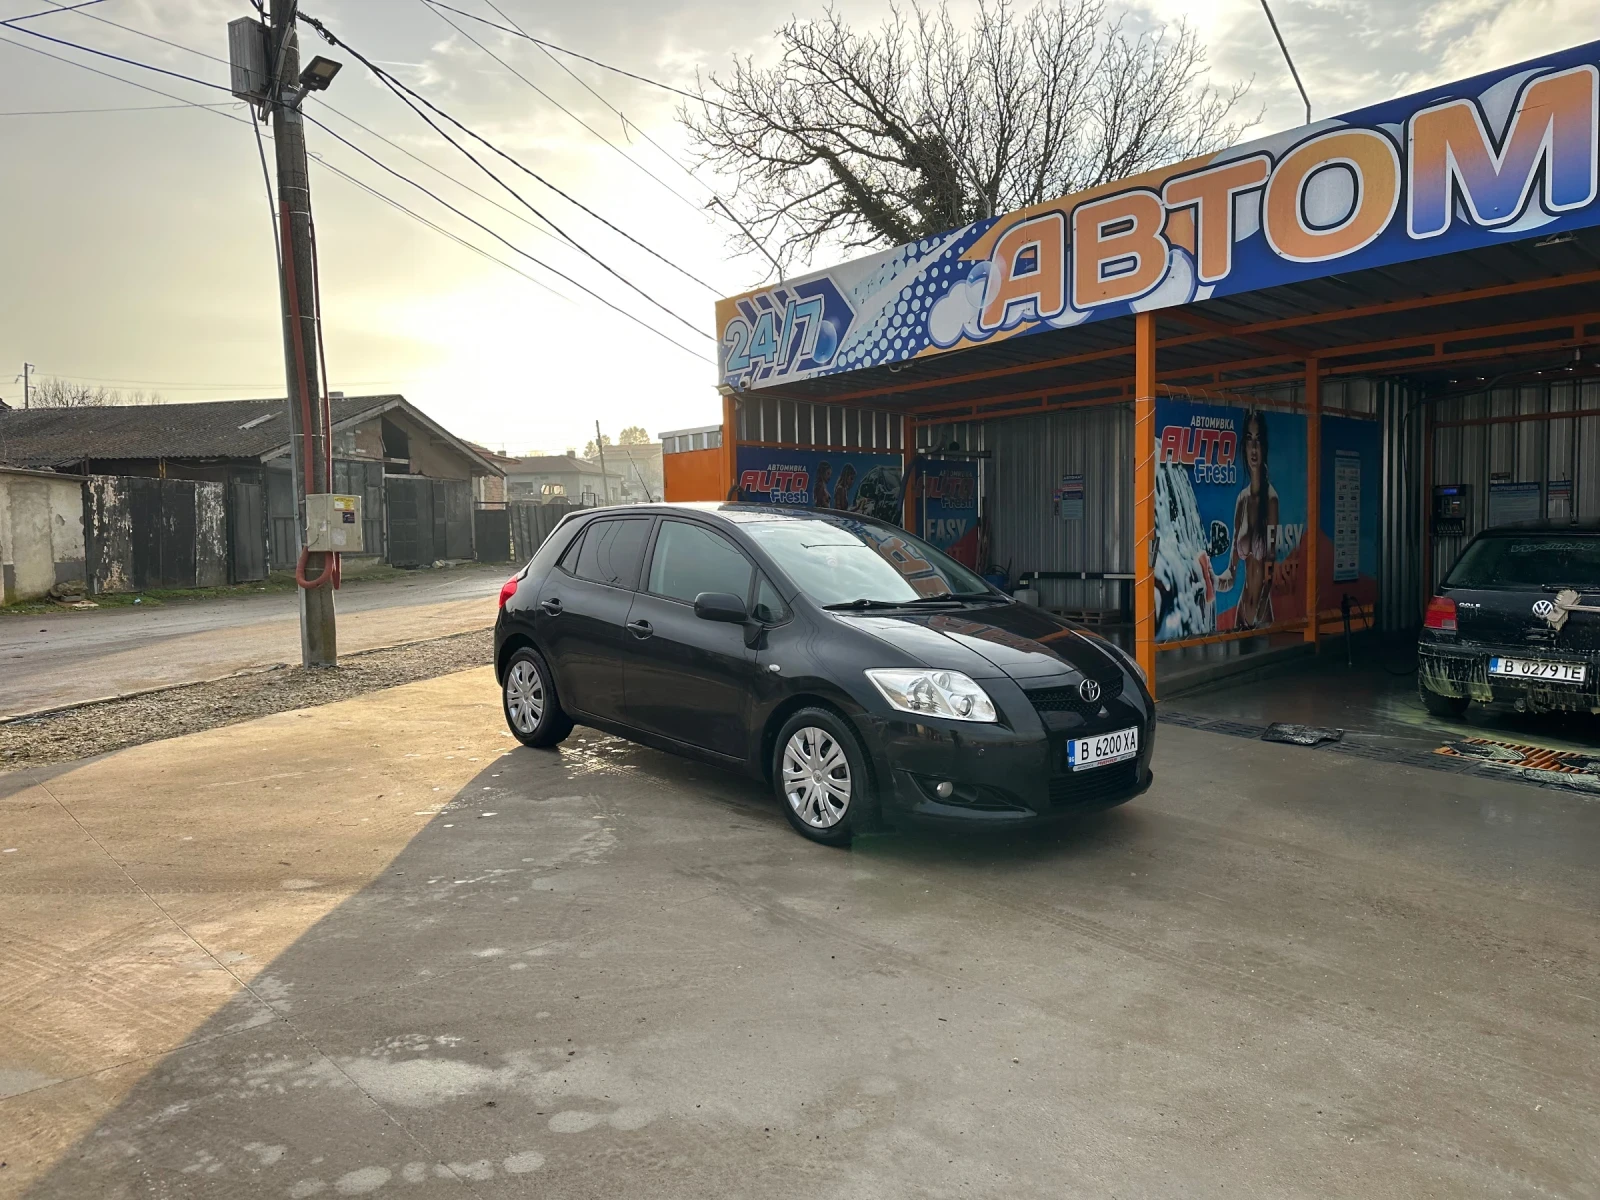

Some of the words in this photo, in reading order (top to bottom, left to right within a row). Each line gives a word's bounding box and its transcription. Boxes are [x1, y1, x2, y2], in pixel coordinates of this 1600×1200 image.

[979, 63, 1599, 330] АВТОМ
[725, 297, 823, 373] 24/7
[1190, 415, 1234, 429] АВТОМИВКА
[1160, 425, 1237, 465] AUTO
[767, 464, 806, 472] АВТОМИВКА
[1194, 457, 1237, 483] Fresh
[740, 470, 809, 492] AUTO
[771, 488, 808, 503] Fresh
[926, 519, 967, 541] EASY
[1266, 524, 1304, 553] EASY
[1504, 660, 1513, 672] B
[1521, 662, 1558, 677] 0279
[1562, 665, 1582, 679] TE
[1081, 742, 1089, 760] B
[1095, 735, 1121, 757] 6200
[1123, 731, 1136, 751] XA
